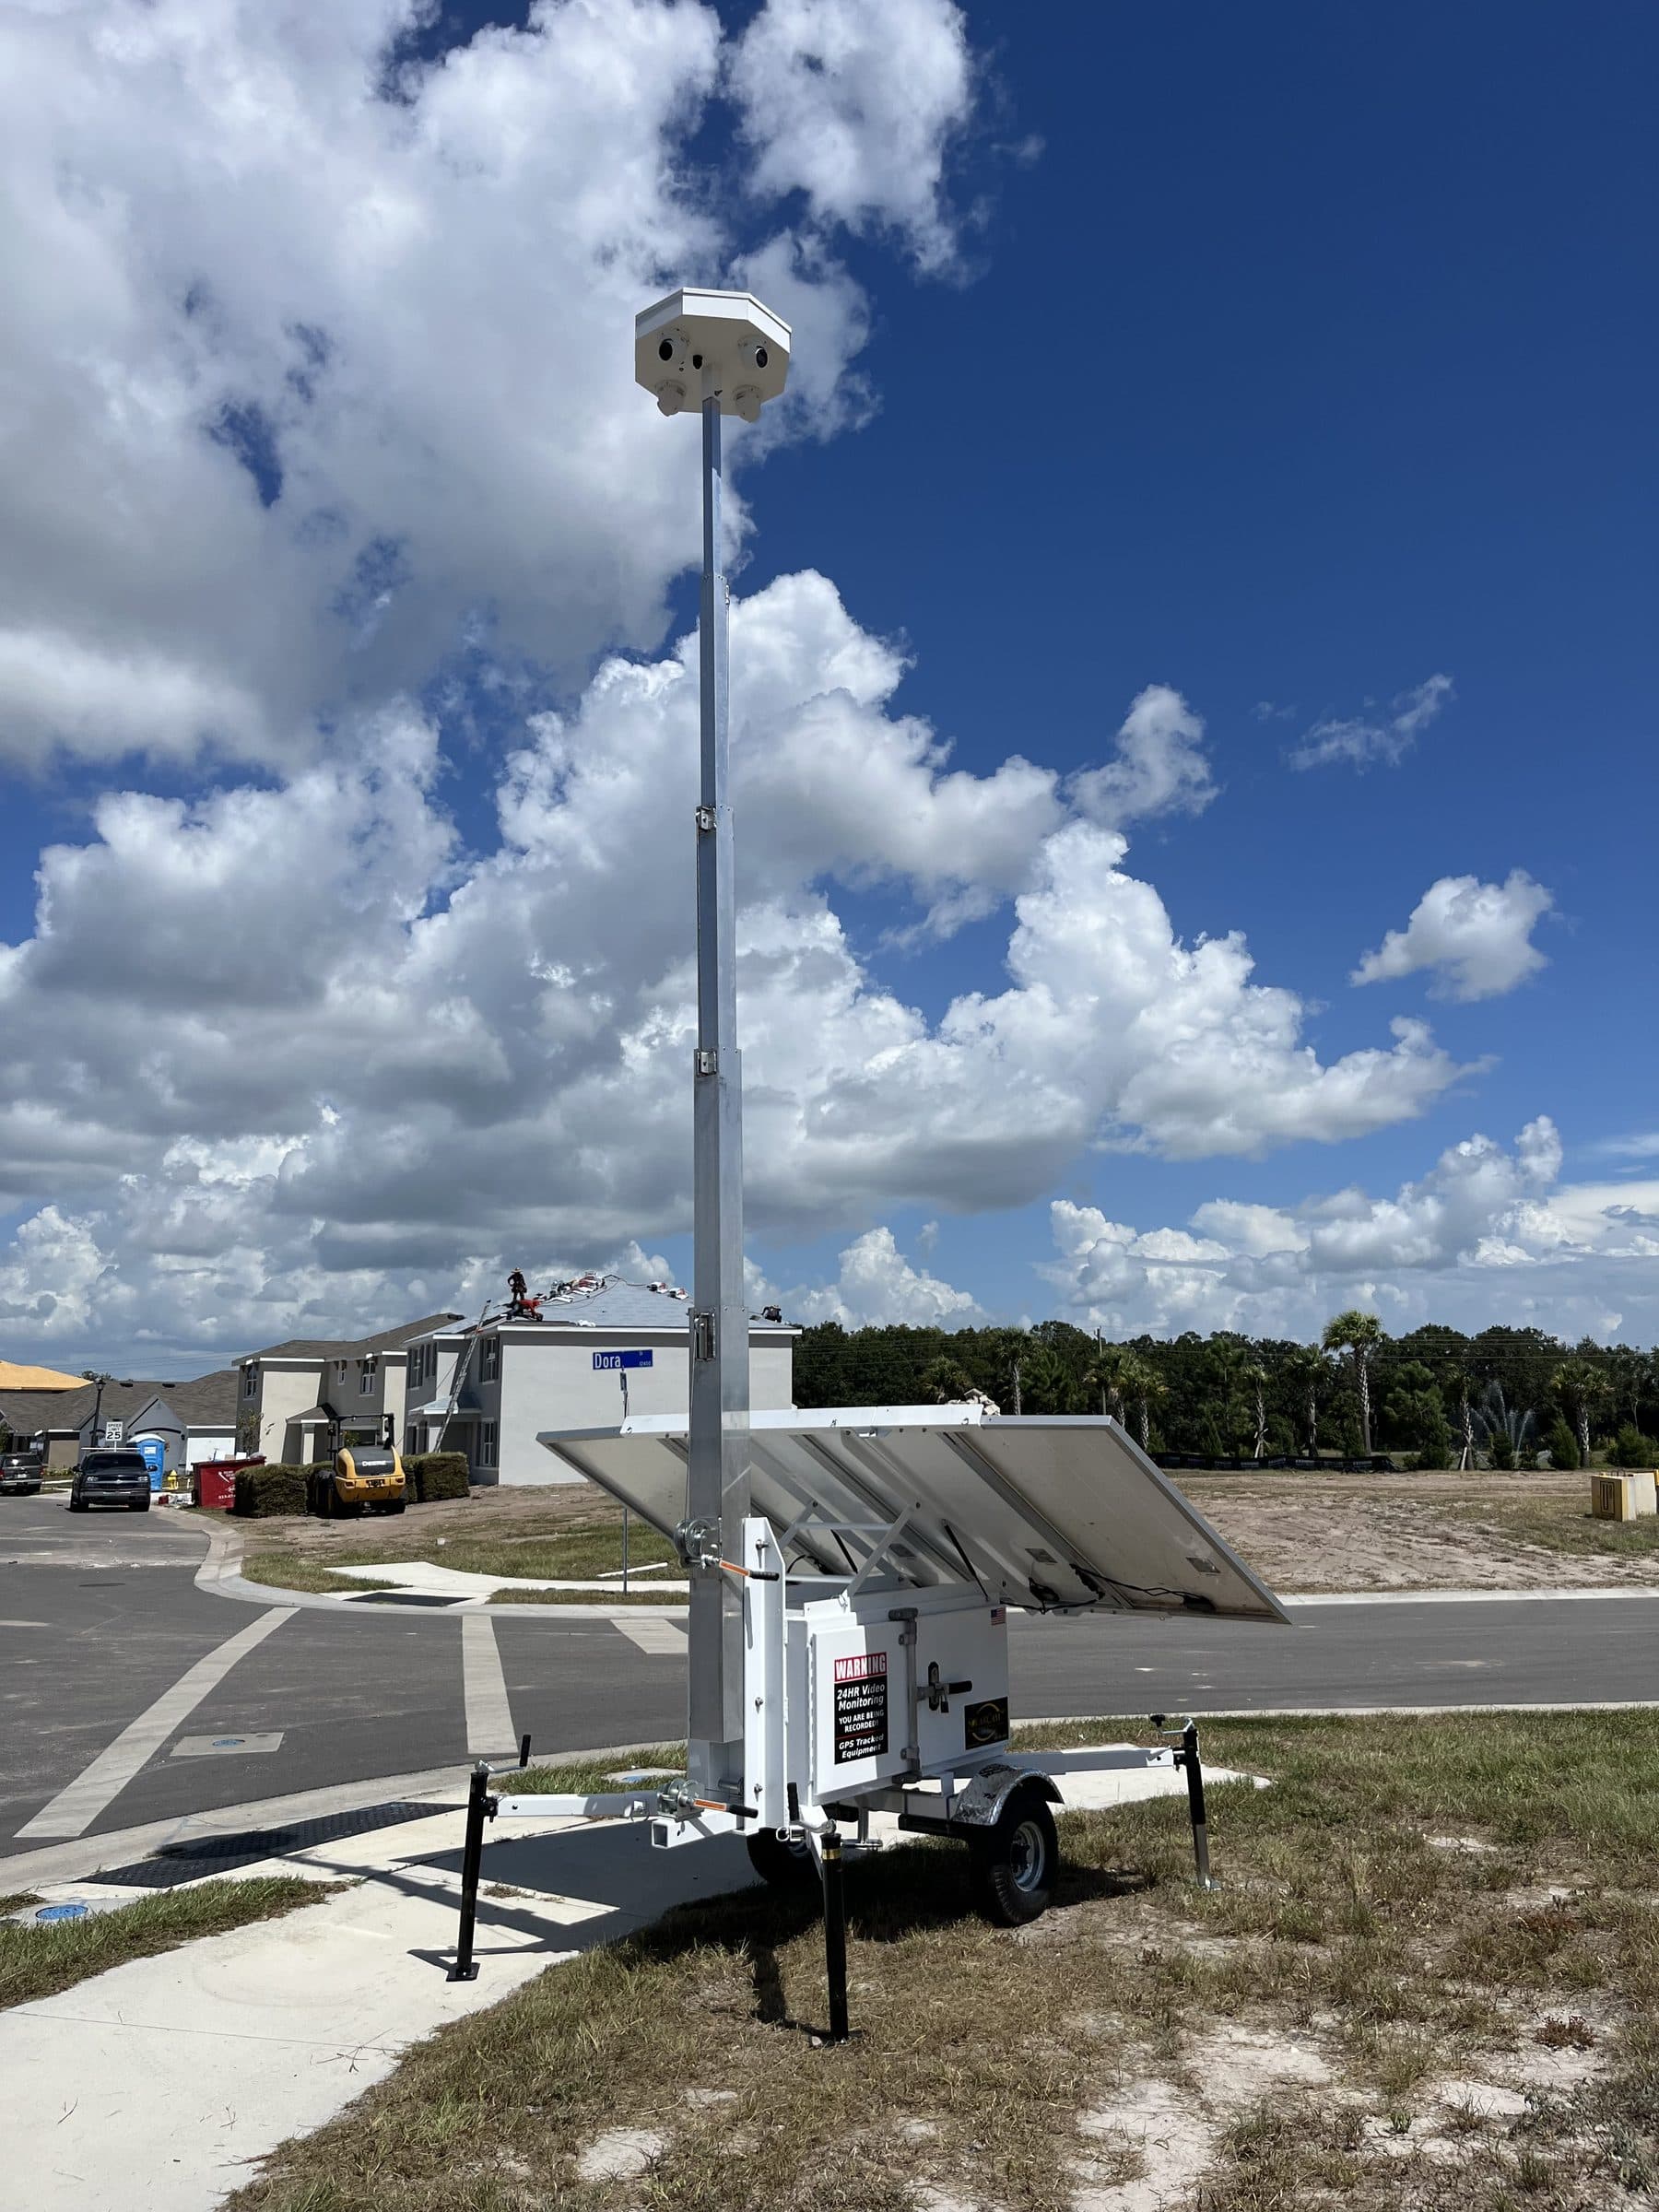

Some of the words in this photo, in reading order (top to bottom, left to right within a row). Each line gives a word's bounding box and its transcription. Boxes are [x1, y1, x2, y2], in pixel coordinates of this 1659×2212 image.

[594, 1353, 621, 1369] Dora
[836, 1654, 886, 1680] WARNING
[837, 1687, 860, 1700] 24HR
[863, 1684, 885, 1695] Video
[838, 1695, 884, 1711] Monitoring
[839, 1715, 852, 1724] YOU
[853, 1712, 865, 1722] ARE
[866, 1710, 884, 1719] BEING
[839, 1740, 854, 1749] GPS
[856, 1734, 884, 1746] Tracked
[842, 1744, 881, 1759] Equipment
